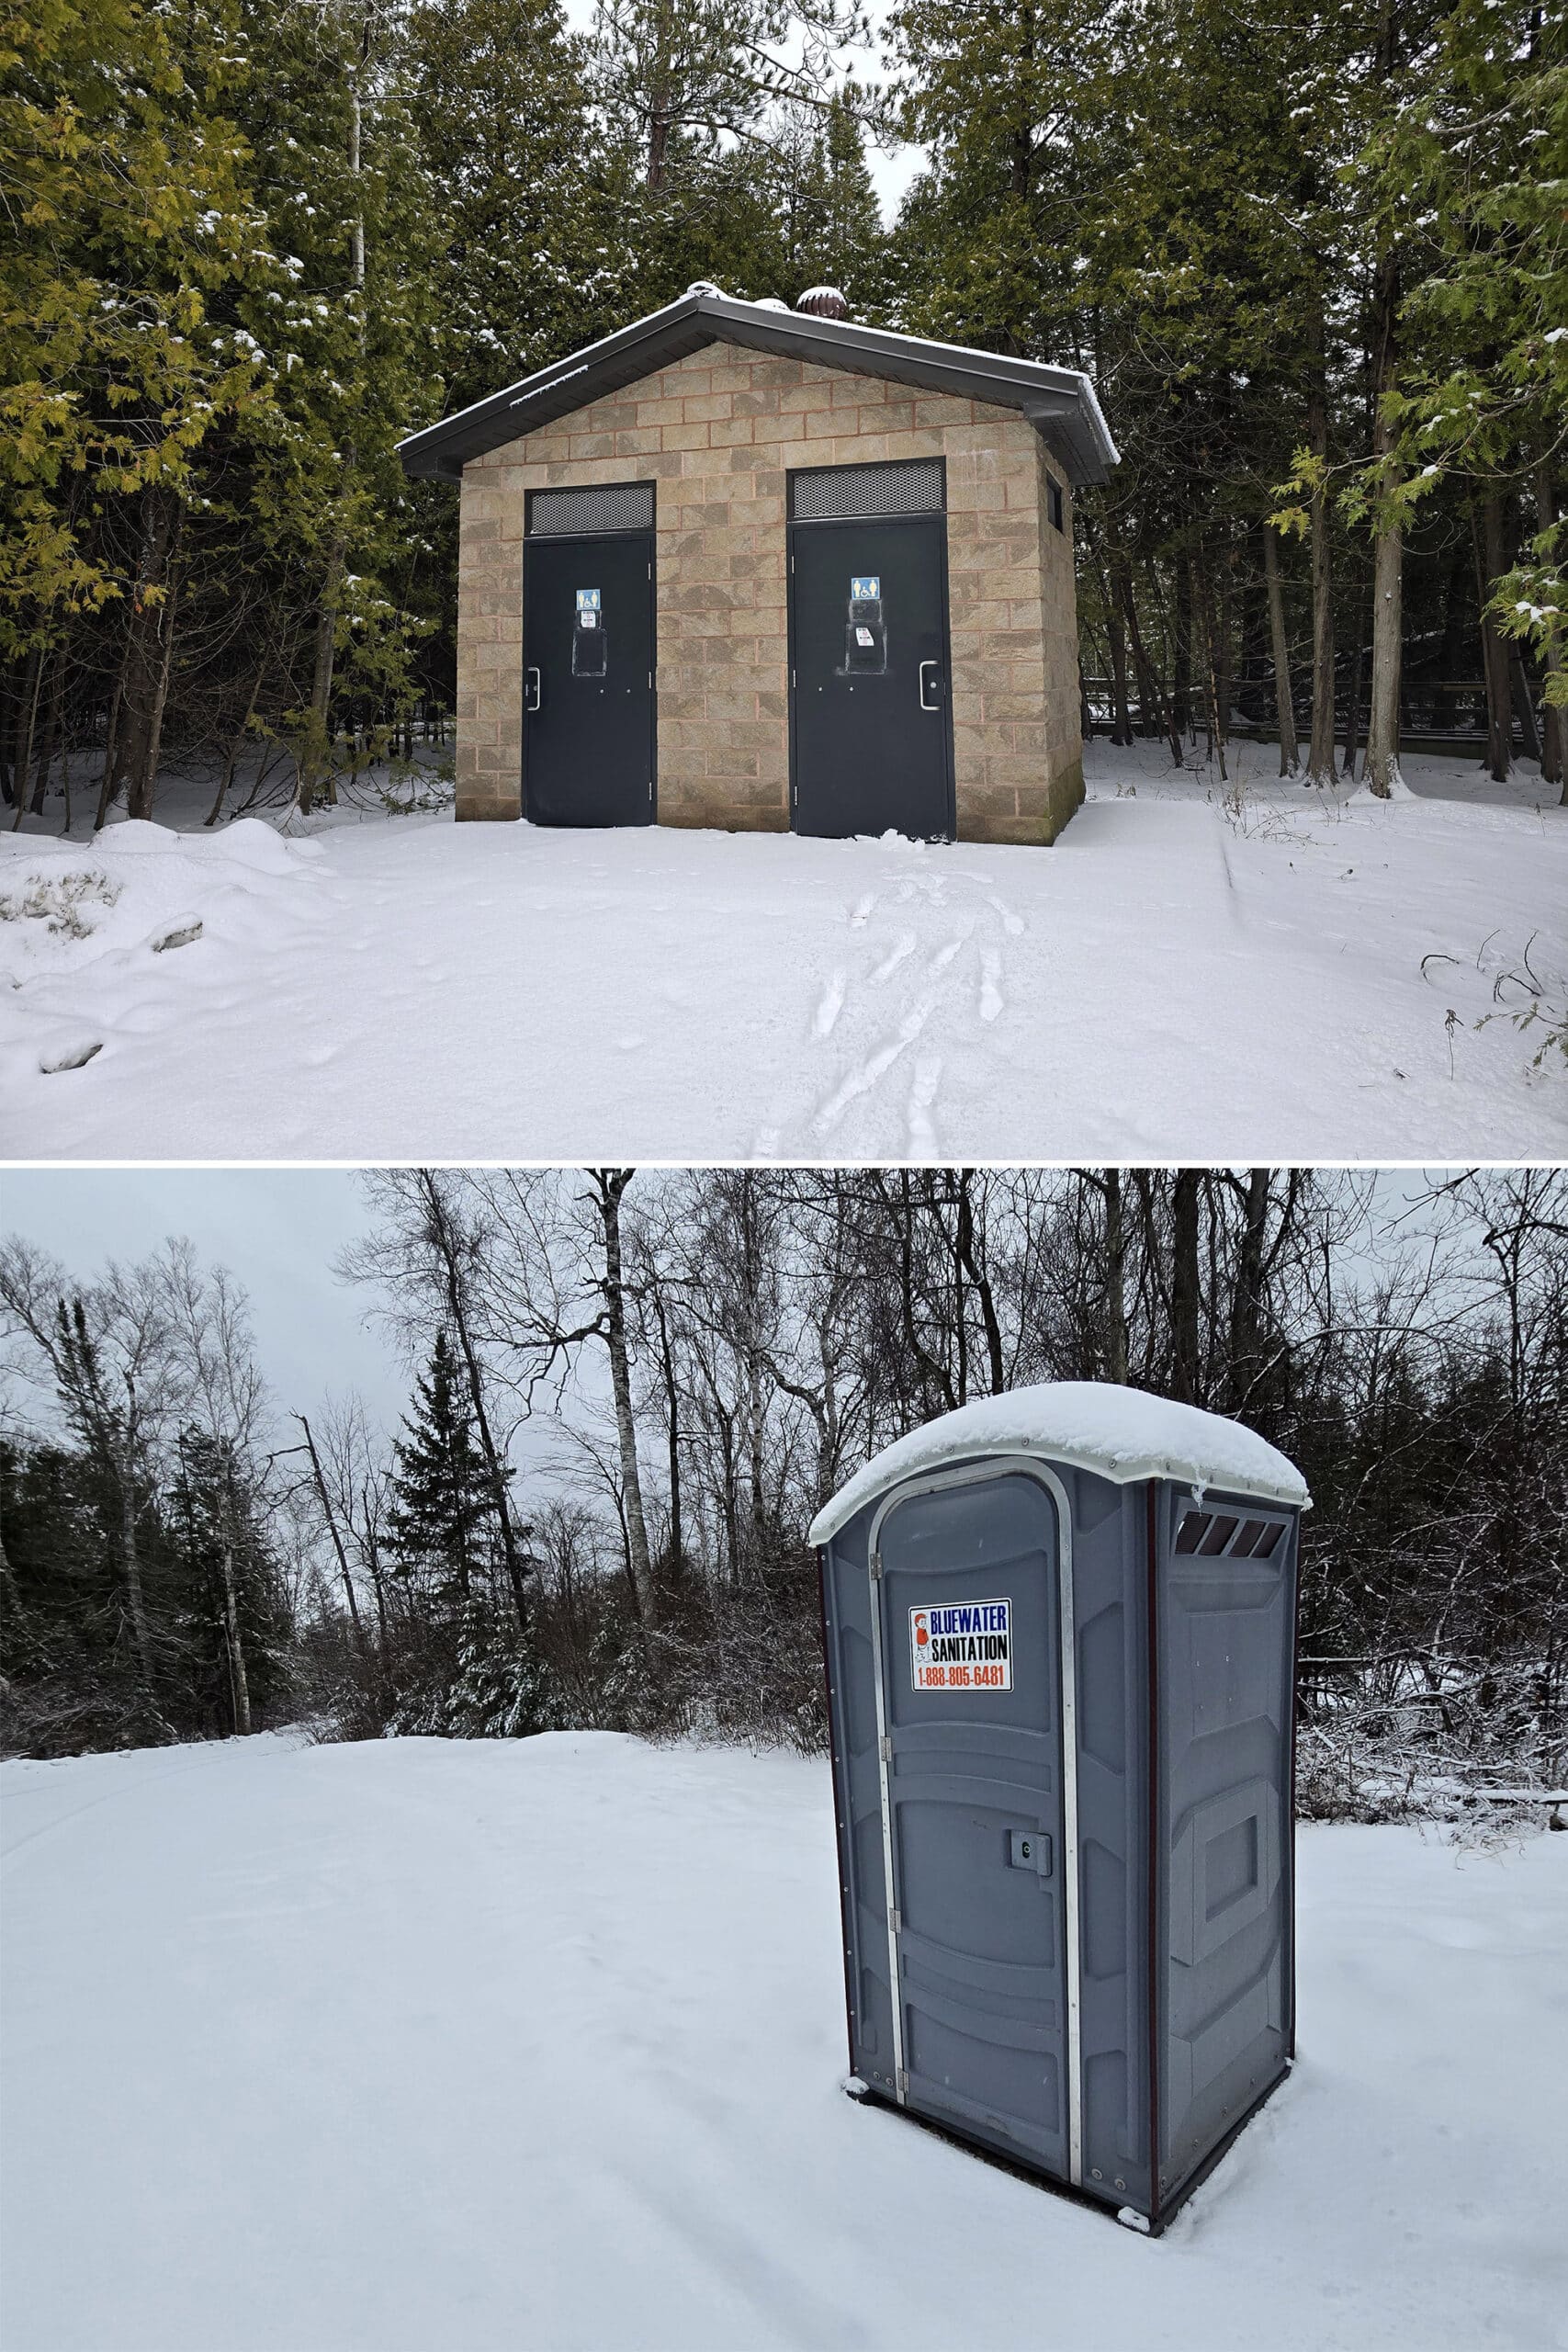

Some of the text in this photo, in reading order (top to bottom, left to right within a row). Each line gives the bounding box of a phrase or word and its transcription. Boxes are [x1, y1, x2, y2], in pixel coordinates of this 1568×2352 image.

[931, 1605, 1007, 1634] BLUEWATER
[931, 1634, 1008, 1662] SANITATION
[918, 1665, 1004, 1686] 1-888-805-6481
